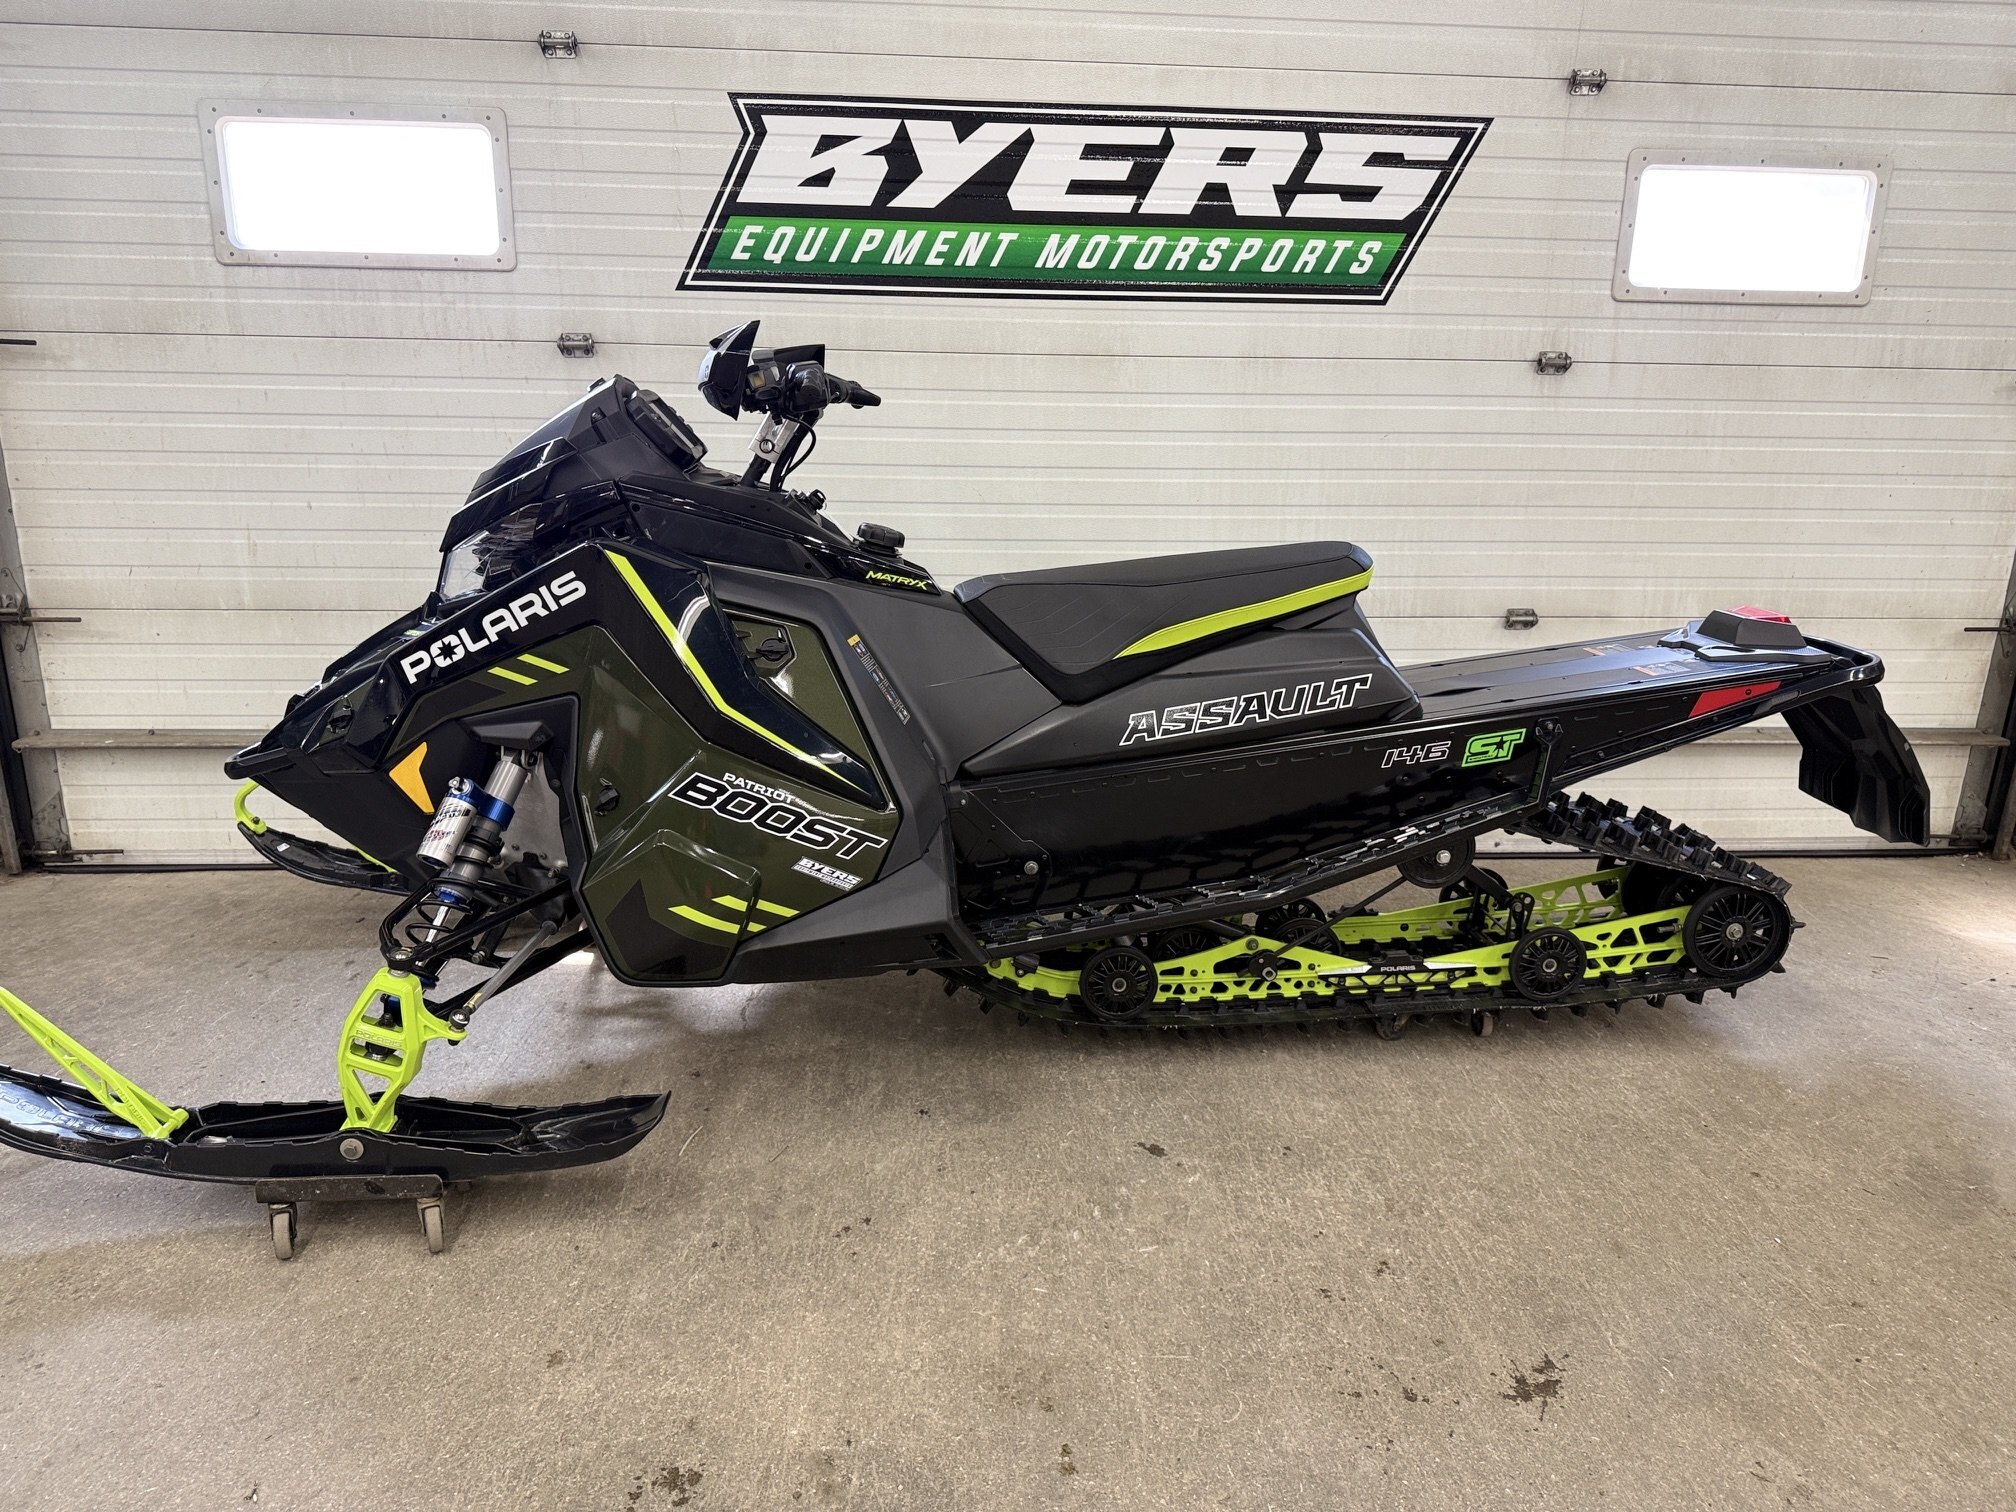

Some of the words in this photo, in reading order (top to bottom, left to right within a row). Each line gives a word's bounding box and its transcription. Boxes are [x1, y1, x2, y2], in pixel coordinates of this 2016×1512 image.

[735, 114, 1460, 220] BYERS
[731, 224, 1018, 268] EQUIPMENT
[1035, 234, 1383, 275] MOTORSPORTS
[865, 570, 928, 591] MATRYX
[400, 570, 587, 684] POLARIS
[1119, 673, 1373, 746] ASSAULT
[1380, 740, 1452, 769] 146
[1461, 727, 1527, 768] ST
[722, 772, 797, 804] PATRIOT
[667, 771, 888, 859] BOOST
[797, 858, 862, 885] BYERS
[1380, 964, 1417, 973] POLARIS
[355, 1029, 403, 1048] POLARIS
